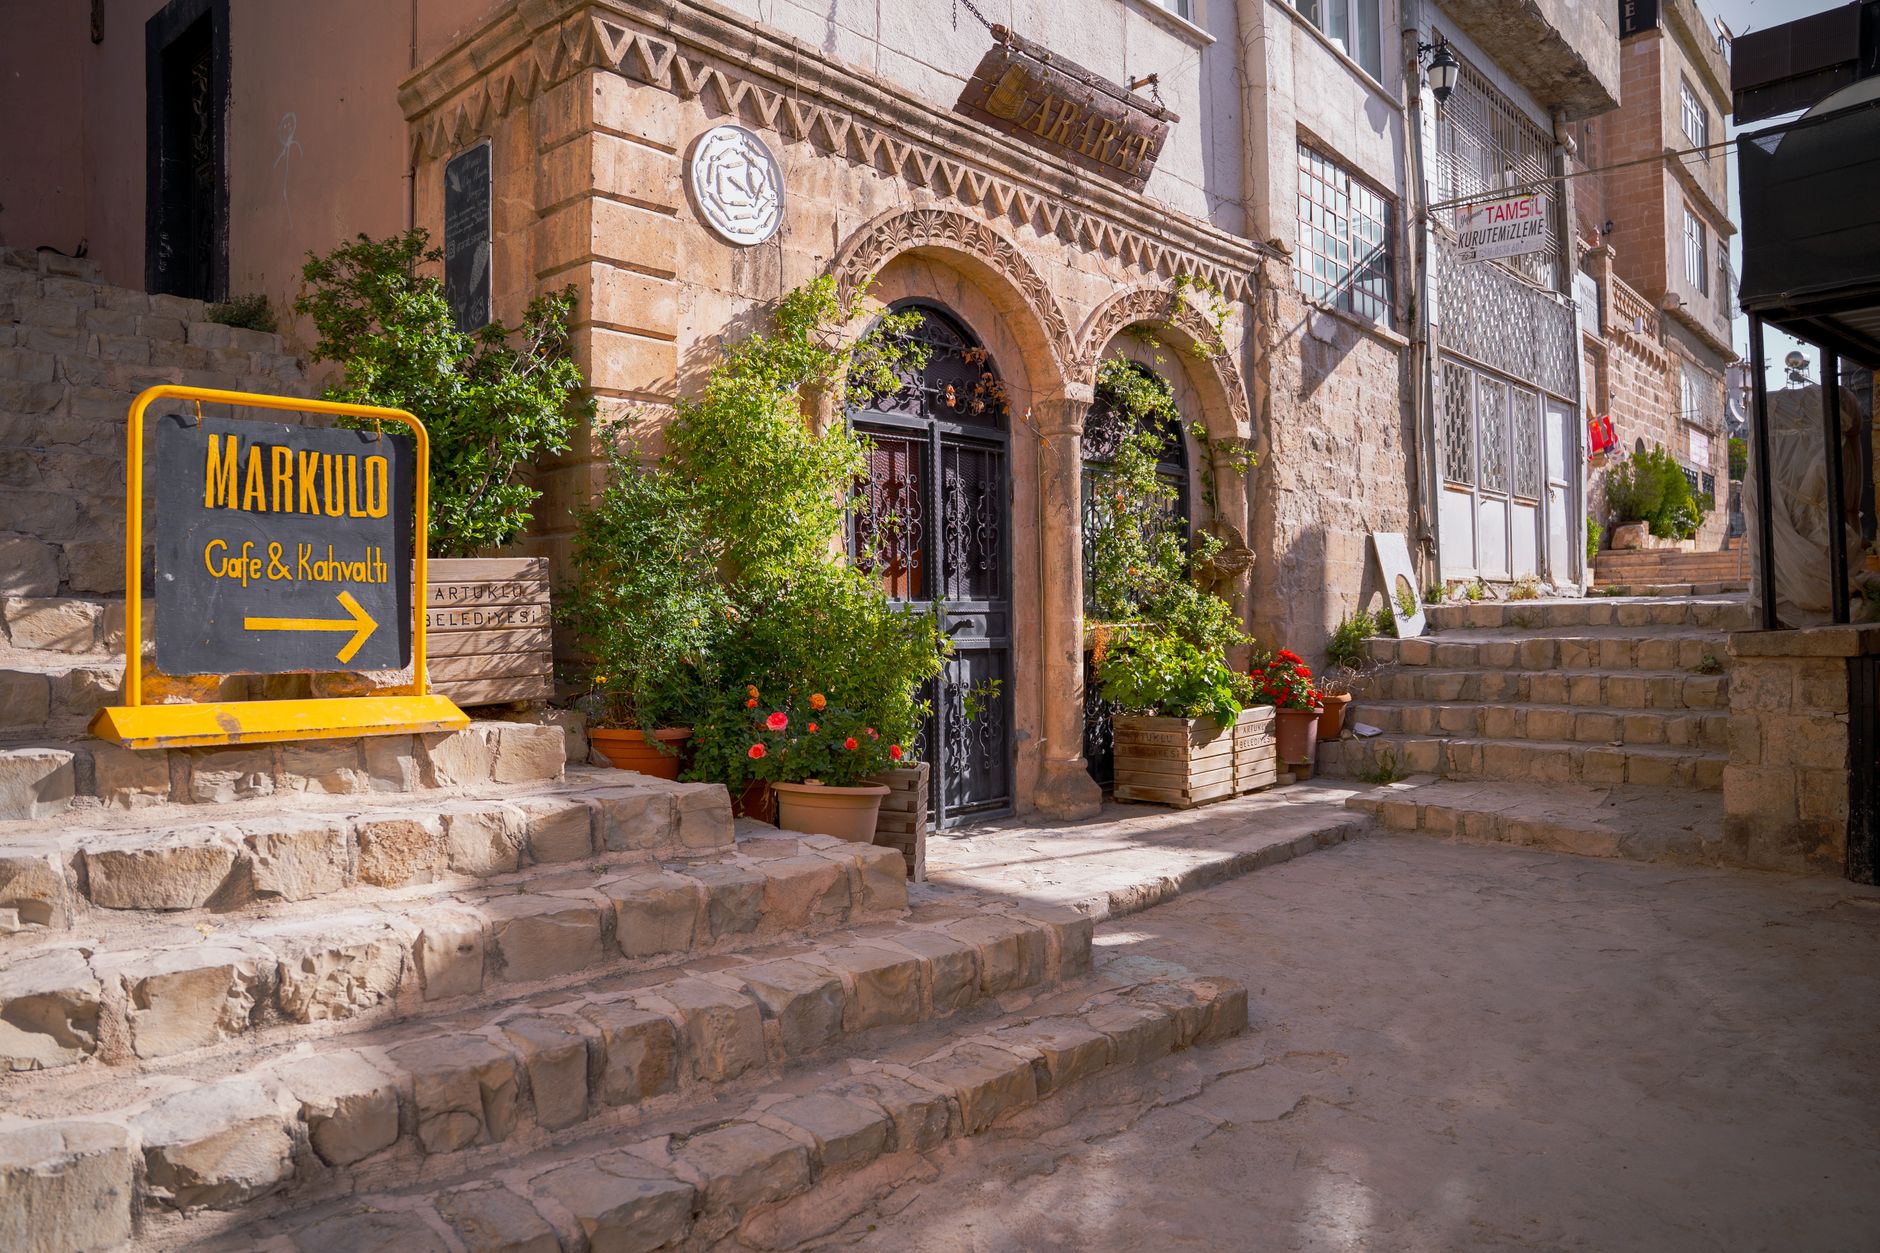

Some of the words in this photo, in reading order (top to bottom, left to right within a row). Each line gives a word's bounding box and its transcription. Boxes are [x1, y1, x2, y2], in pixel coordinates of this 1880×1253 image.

[1018, 95, 1155, 176] ARARAT
[205, 433, 389, 519] MARKULO
[204, 539, 262, 588] Cafe
[267, 541, 293, 581] &
[434, 585, 522, 601] ARTUKLU
